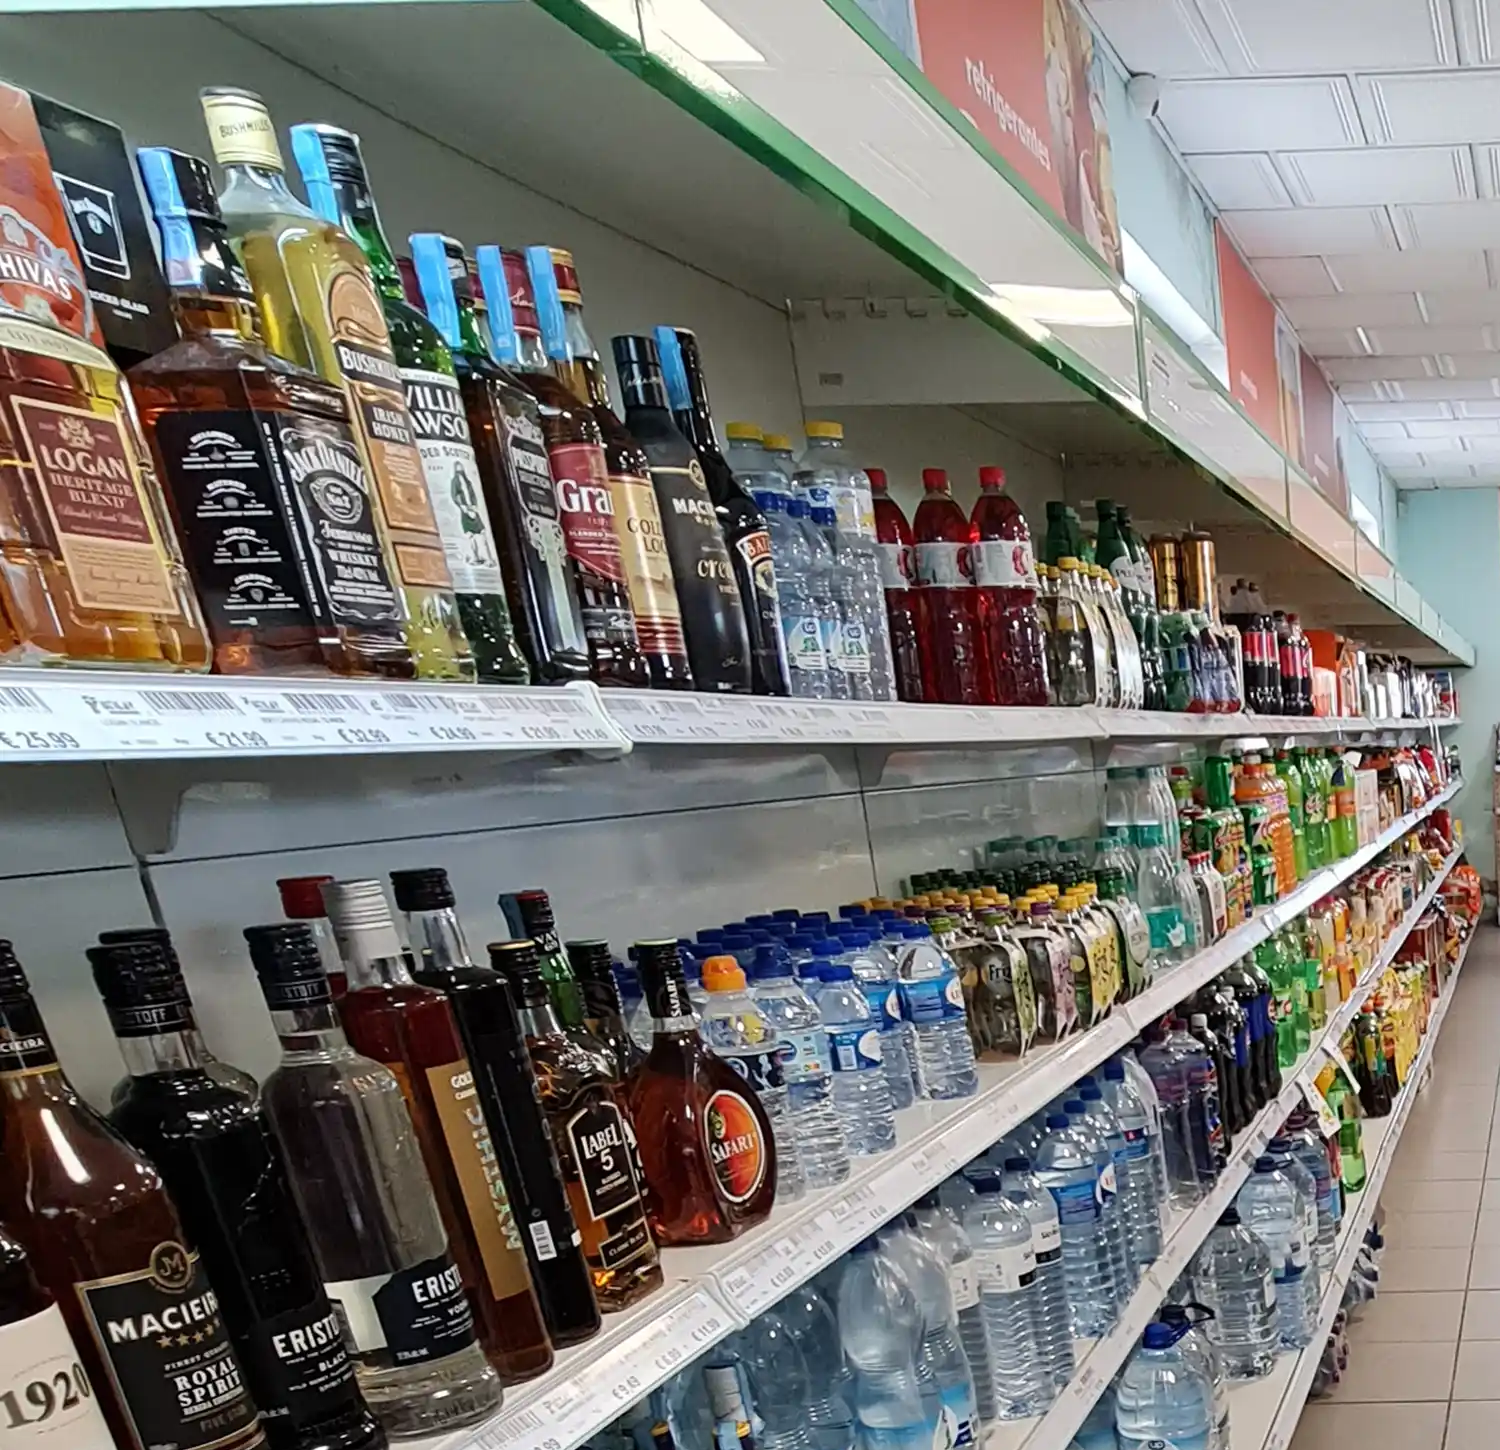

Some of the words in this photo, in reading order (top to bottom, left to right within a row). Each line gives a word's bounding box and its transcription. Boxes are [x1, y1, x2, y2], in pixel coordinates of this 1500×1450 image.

[964, 57, 1052, 171] refrigerantes
[41, 444, 129, 489] LOGAN
[50, 474, 134, 500] HERITAGE
[67, 489, 127, 511] BLEND
[24, 730, 80, 749] 25.99
[581, 1124, 622, 1160] LABEL
[601, 1149, 614, 1170] 5
[712, 1132, 755, 1164] SAFARI
[174, 1357, 236, 1392] ROYAL
[177, 1371, 241, 1408] SPIRIT
[2, 1361, 91, 1430] 1920
